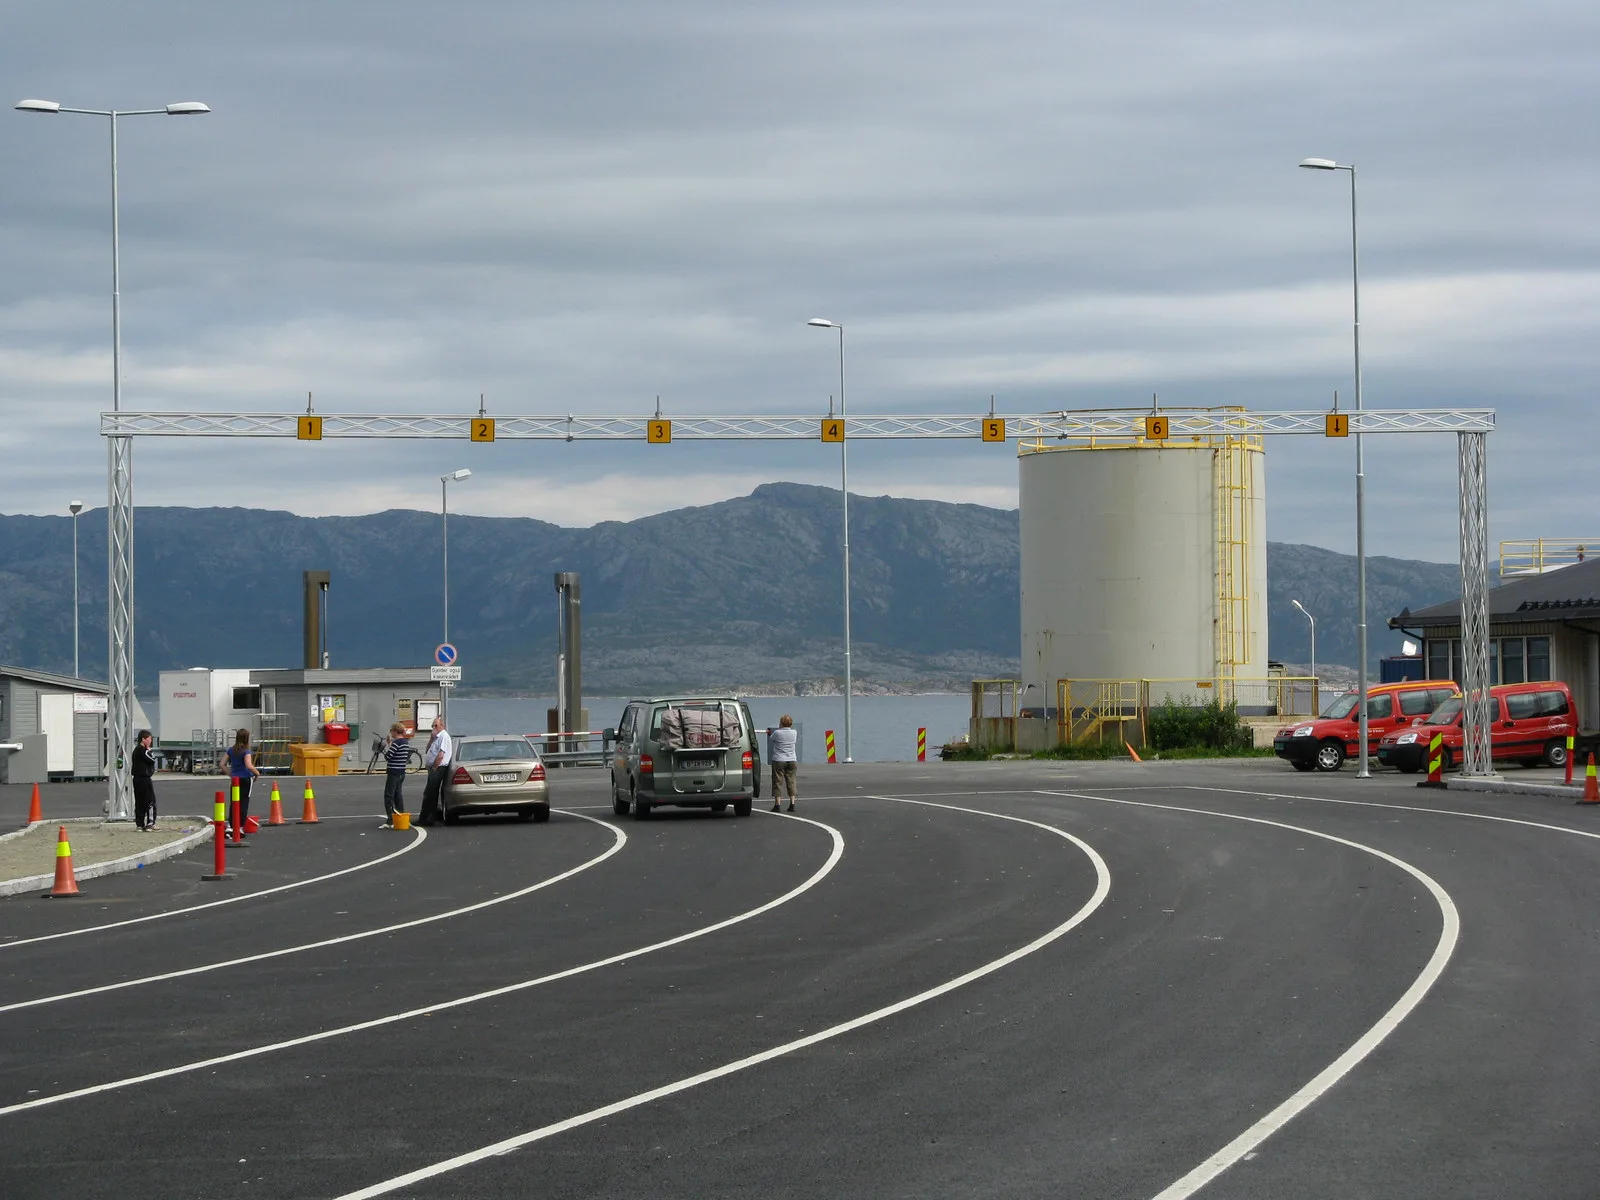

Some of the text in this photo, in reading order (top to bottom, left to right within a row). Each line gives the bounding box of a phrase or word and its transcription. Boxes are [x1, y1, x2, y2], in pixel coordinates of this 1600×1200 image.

[478, 423, 488, 437] 2
[655, 424, 664, 438] 3
[828, 423, 838, 437] 4
[990, 423, 998, 437] 5
[1152, 421, 1161, 435] 6
